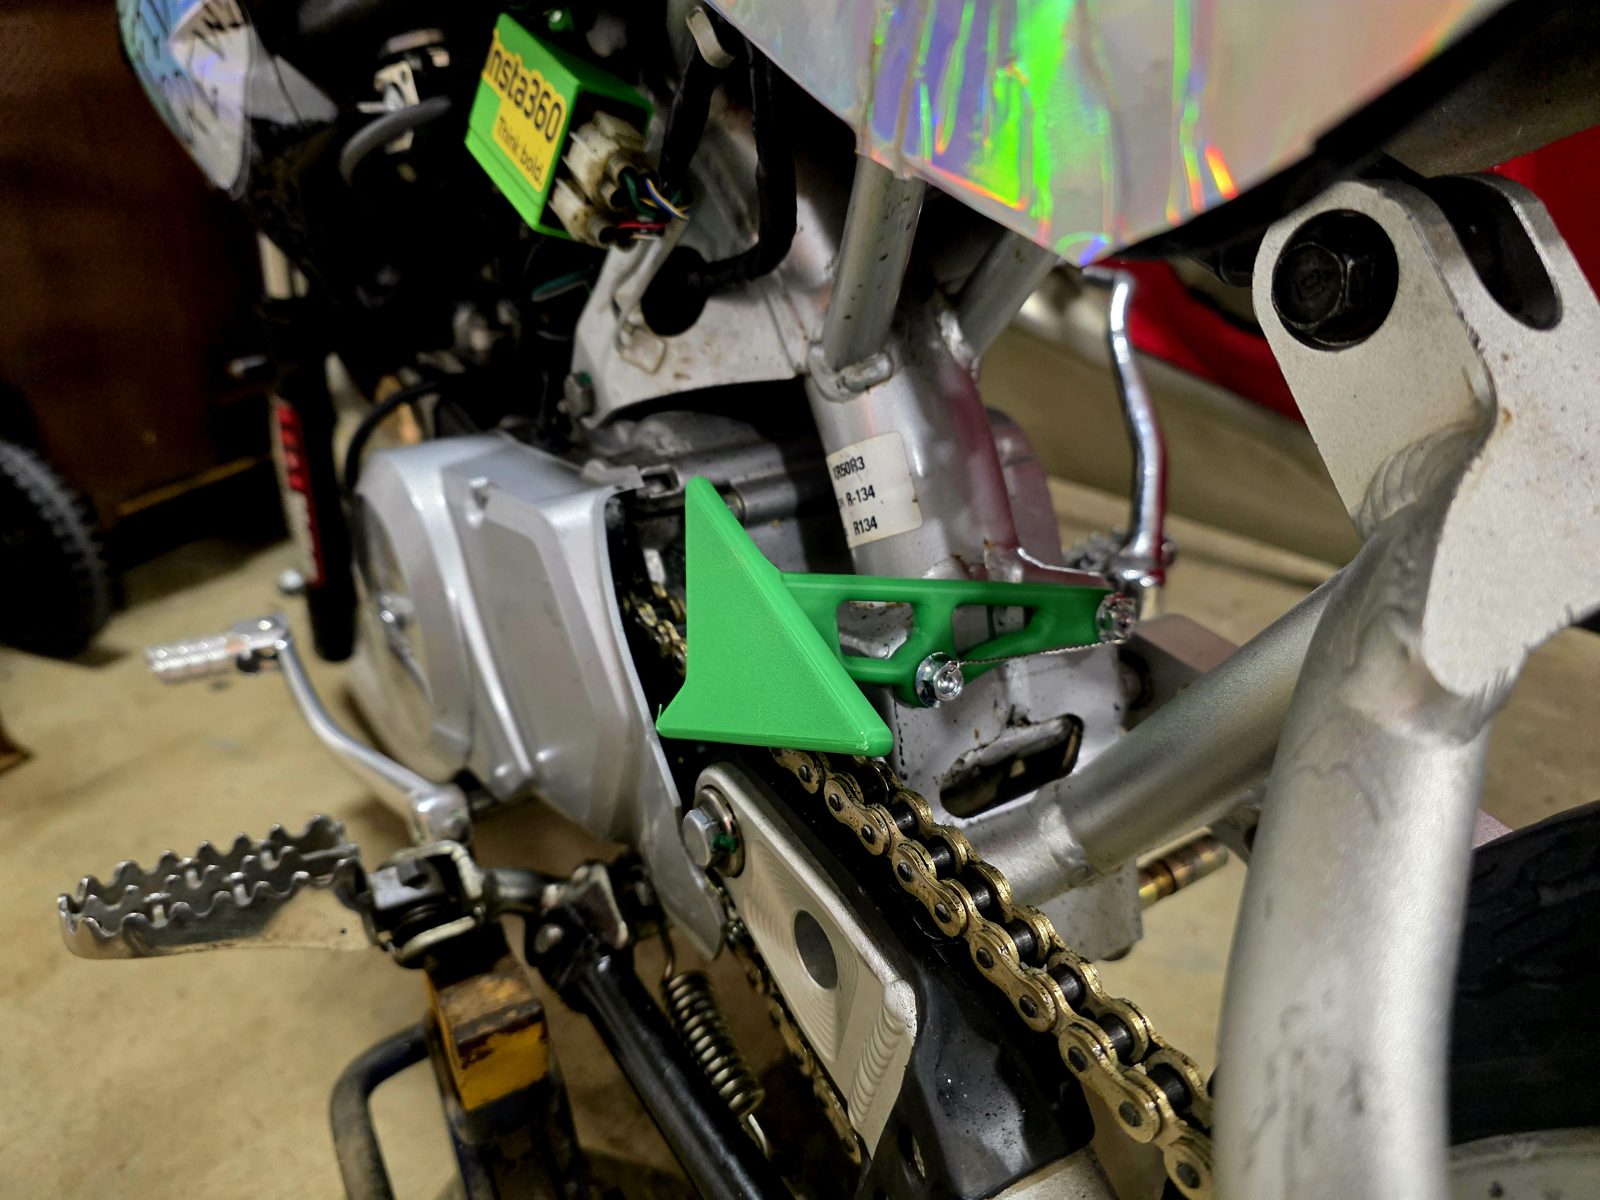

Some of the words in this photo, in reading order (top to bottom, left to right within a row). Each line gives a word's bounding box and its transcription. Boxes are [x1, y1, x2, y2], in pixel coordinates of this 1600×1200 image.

[488, 49, 562, 143] nsta360
[497, 116, 520, 158] Think
[845, 485, 875, 506] R-134
[853, 516, 877, 535] R134
